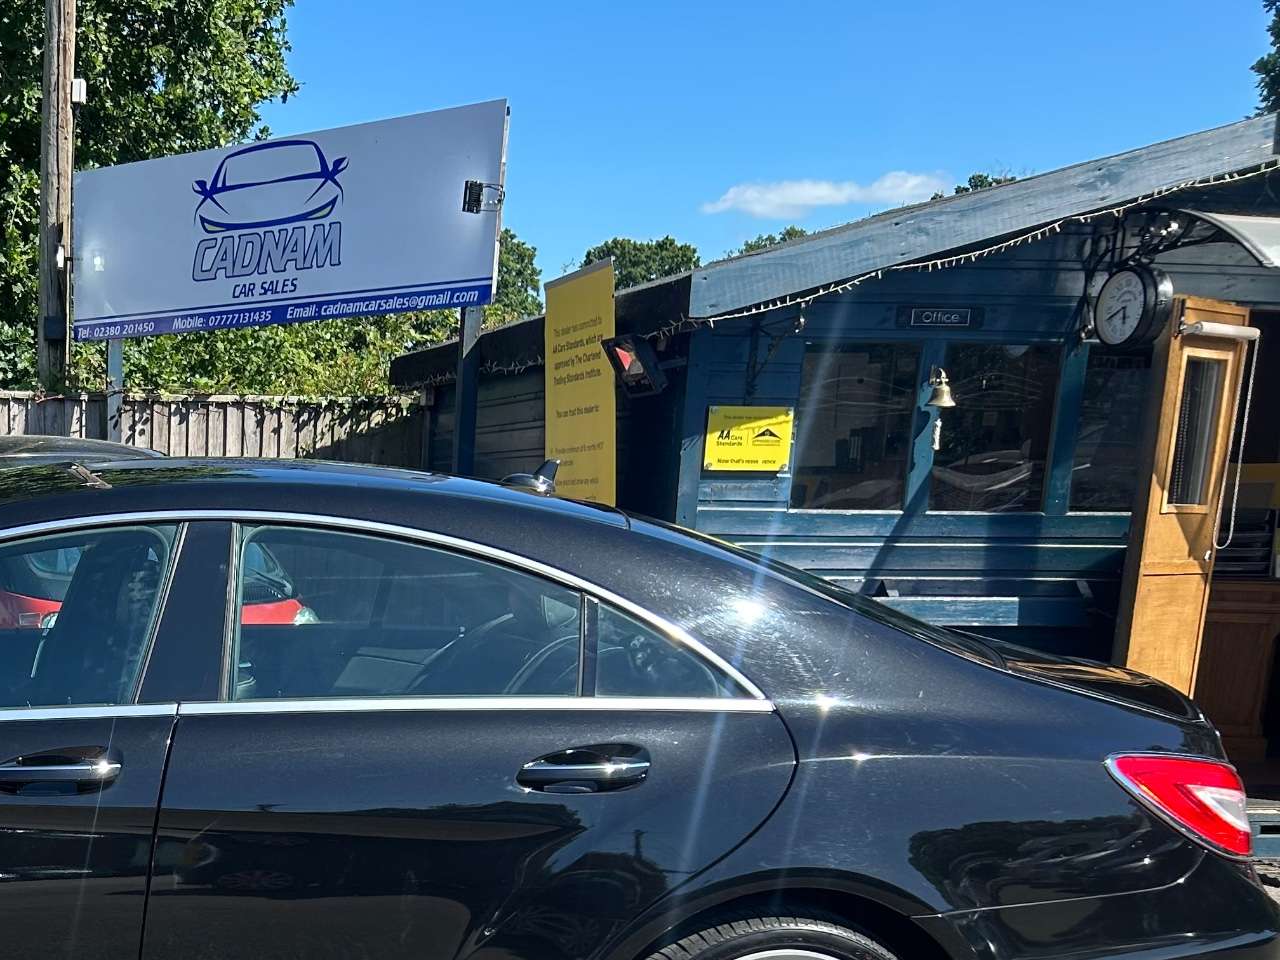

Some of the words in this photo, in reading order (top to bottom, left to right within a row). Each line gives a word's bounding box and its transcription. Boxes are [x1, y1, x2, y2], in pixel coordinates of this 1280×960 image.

[192, 221, 341, 281] CADNAM
[232, 282, 256, 298] CAR
[259, 278, 298, 296] SALES
[77, 327, 92, 339] Tel:
[94, 325, 120, 338] 02380
[122, 322, 154, 335] 201450
[172, 317, 206, 330] Mobile:
[208, 310, 271, 326] 07777131435
[287, 304, 319, 319] Email:
[321, 289, 478, 316] cadnamcarsales@gmail.com
[922, 311, 959, 322] Office
[717, 429, 730, 440] AA
